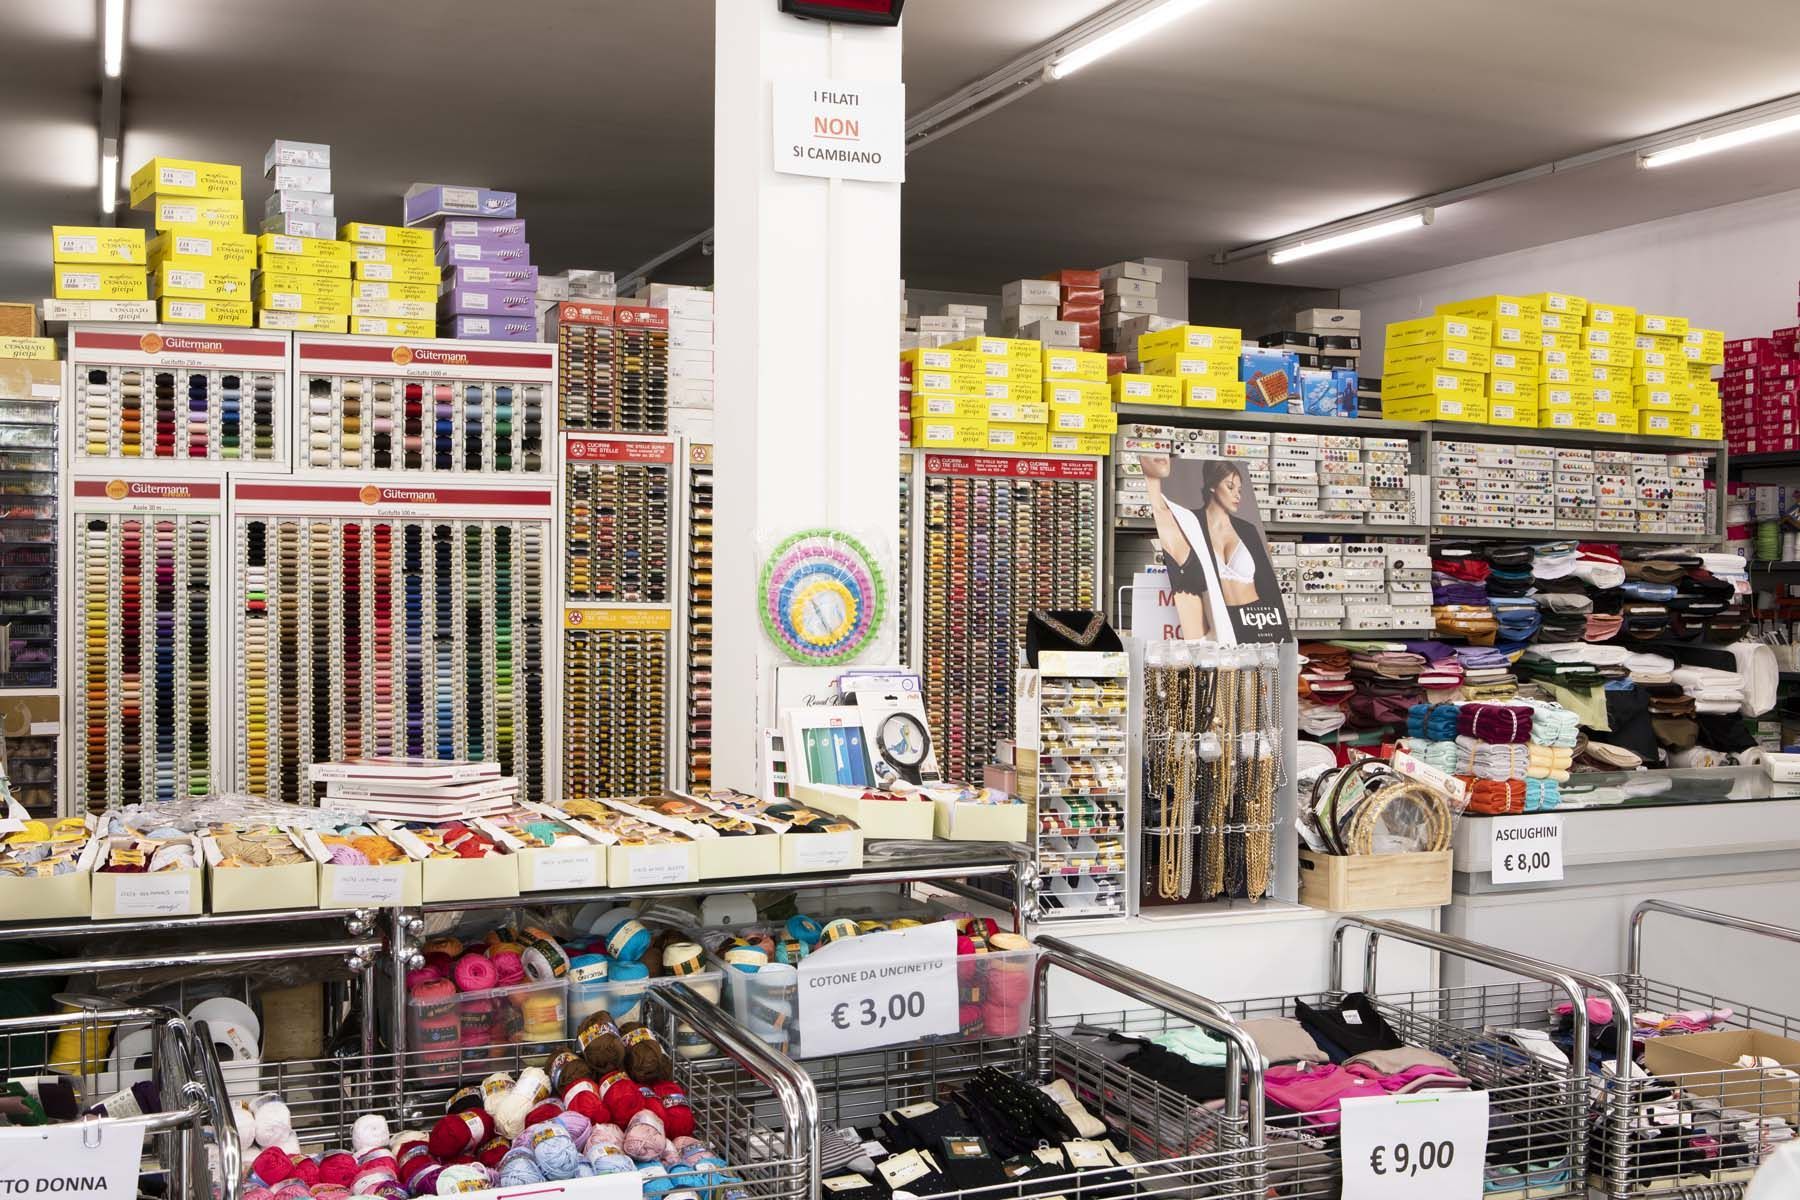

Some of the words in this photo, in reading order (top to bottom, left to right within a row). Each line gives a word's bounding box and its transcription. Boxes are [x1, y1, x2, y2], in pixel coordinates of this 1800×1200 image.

[813, 91, 818, 102] I
[822, 92, 859, 106] FILATI
[814, 116, 859, 137] NON
[793, 145, 804, 158] SI
[808, 147, 882, 164] CAMBIANO
[166, 338, 222, 350] Gütermann
[415, 350, 466, 361] Gütermann
[131, 483, 188, 494] Gütermann
[383, 489, 435, 499] Gütermann
[1239, 607, 1282, 630] lepel
[1495, 826, 1557, 841] ASCIUGHINI
[1504, 854, 1513, 871] €
[1518, 852, 1550, 873] 8,00
[809, 972, 857, 989] COTONE
[861, 971, 876, 981] DA
[880, 960, 943, 978] UNCINETTO
[831, 1003, 850, 1030] €
[860, 991, 925, 1029] 3,00
[1370, 1145, 1386, 1175] €
[1394, 1141, 1454, 1177] 9,00
[0, 1179, 29, 1194] TO
[36, 1176, 107, 1192] DONNA
